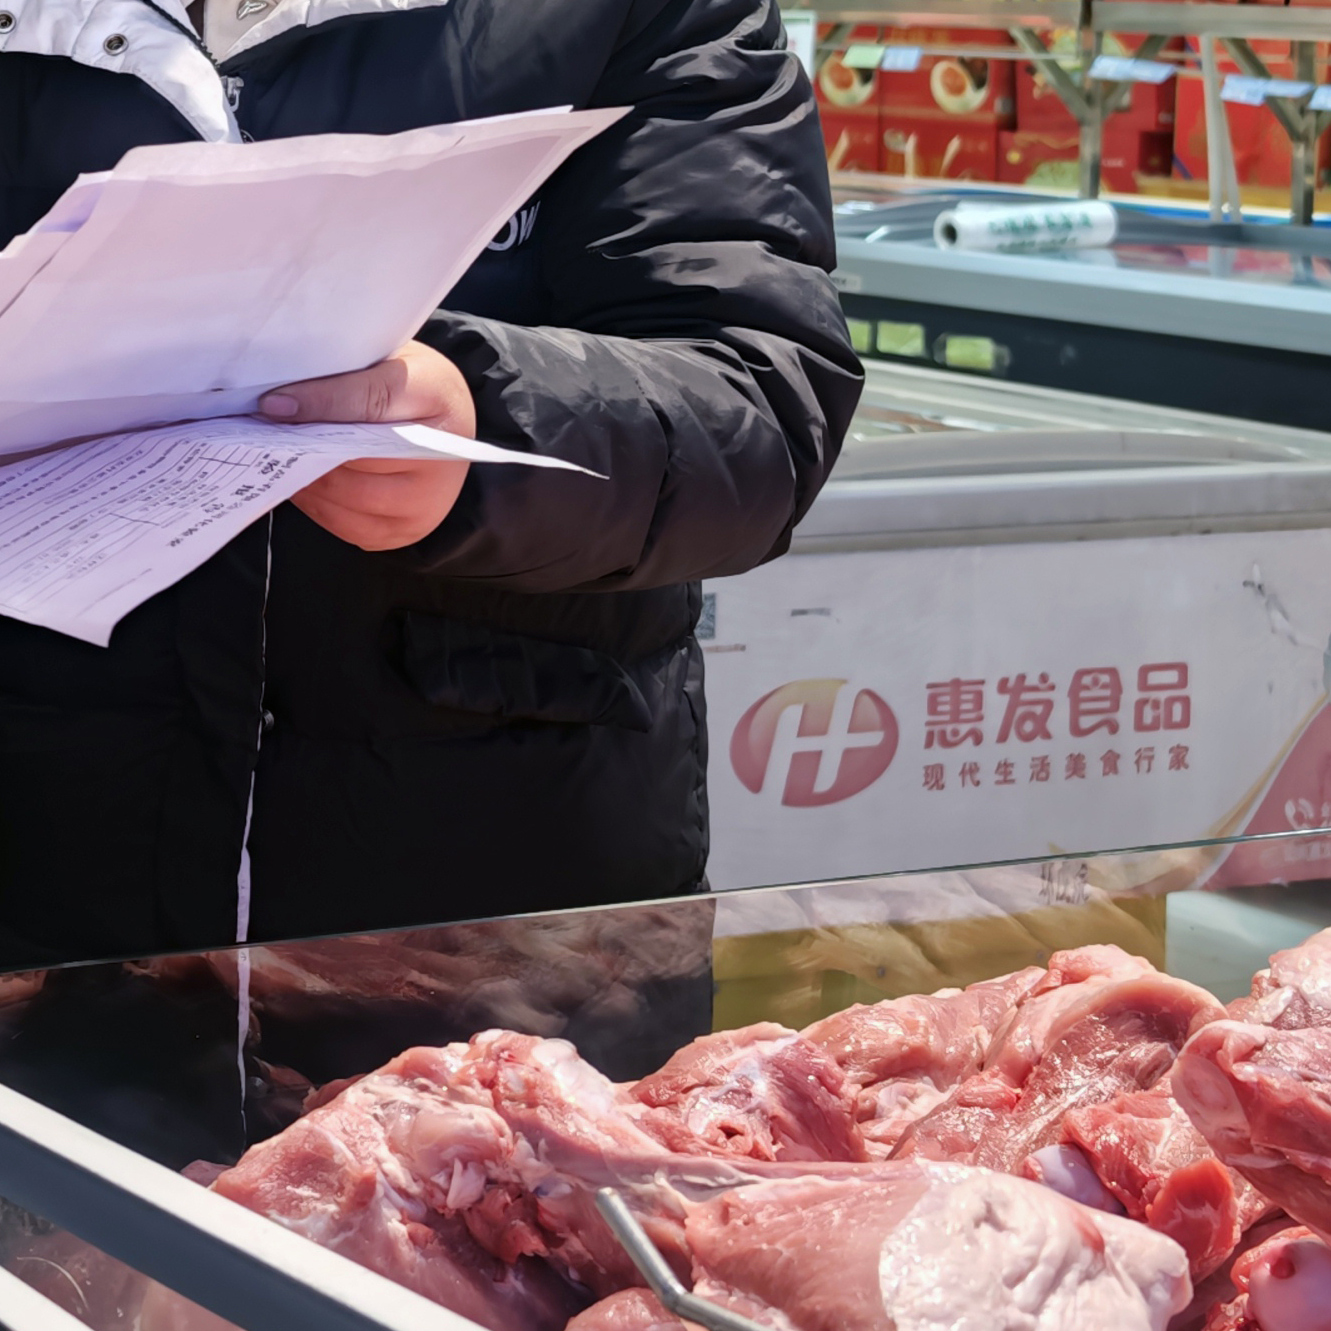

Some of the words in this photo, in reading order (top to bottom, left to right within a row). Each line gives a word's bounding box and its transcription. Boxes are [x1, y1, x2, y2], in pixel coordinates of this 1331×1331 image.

[923, 661, 1192, 750] 惠发食品
[921, 743, 1191, 792] 现代生活美食行家
